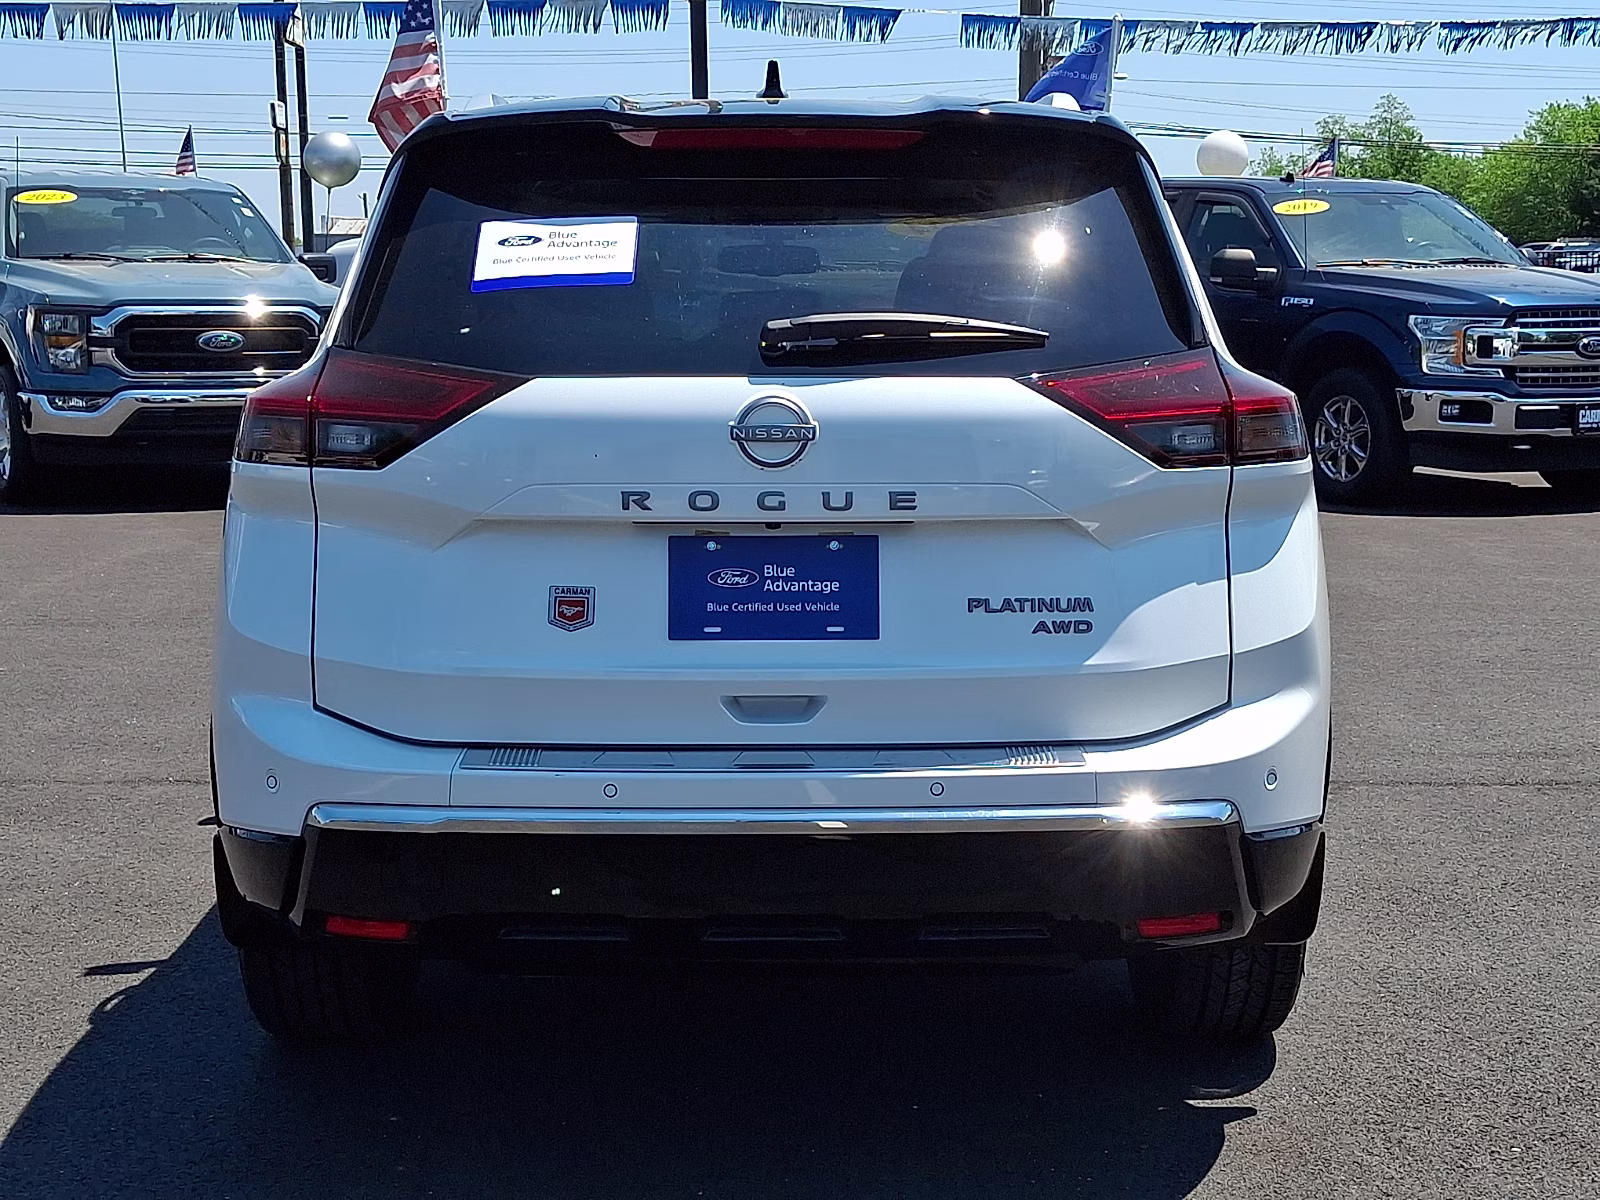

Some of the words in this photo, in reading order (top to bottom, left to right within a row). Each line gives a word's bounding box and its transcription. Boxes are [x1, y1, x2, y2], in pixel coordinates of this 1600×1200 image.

[25, 193, 67, 201] 2023
[1285, 201, 1318, 212] 2019
[548, 231, 578, 239] Blue
[503, 236, 536, 247] Ford
[547, 238, 618, 249] Advantage
[515, 254, 555, 264] Certified
[557, 254, 581, 262] Used
[210, 336, 234, 347] Ford
[732, 427, 814, 439] NISSAN
[620, 490, 918, 512] ROGUE
[763, 564, 796, 577] Blue
[717, 570, 749, 584] Ford
[554, 587, 591, 596] CARMAN
[763, 578, 840, 594] Advantage
[706, 602, 729, 612] Blue
[731, 602, 774, 612] Certified
[776, 602, 801, 612] Used
[804, 602, 840, 612] Vehicle
[967, 597, 1094, 613] PLATINUM
[1031, 619, 1093, 634] AWD
